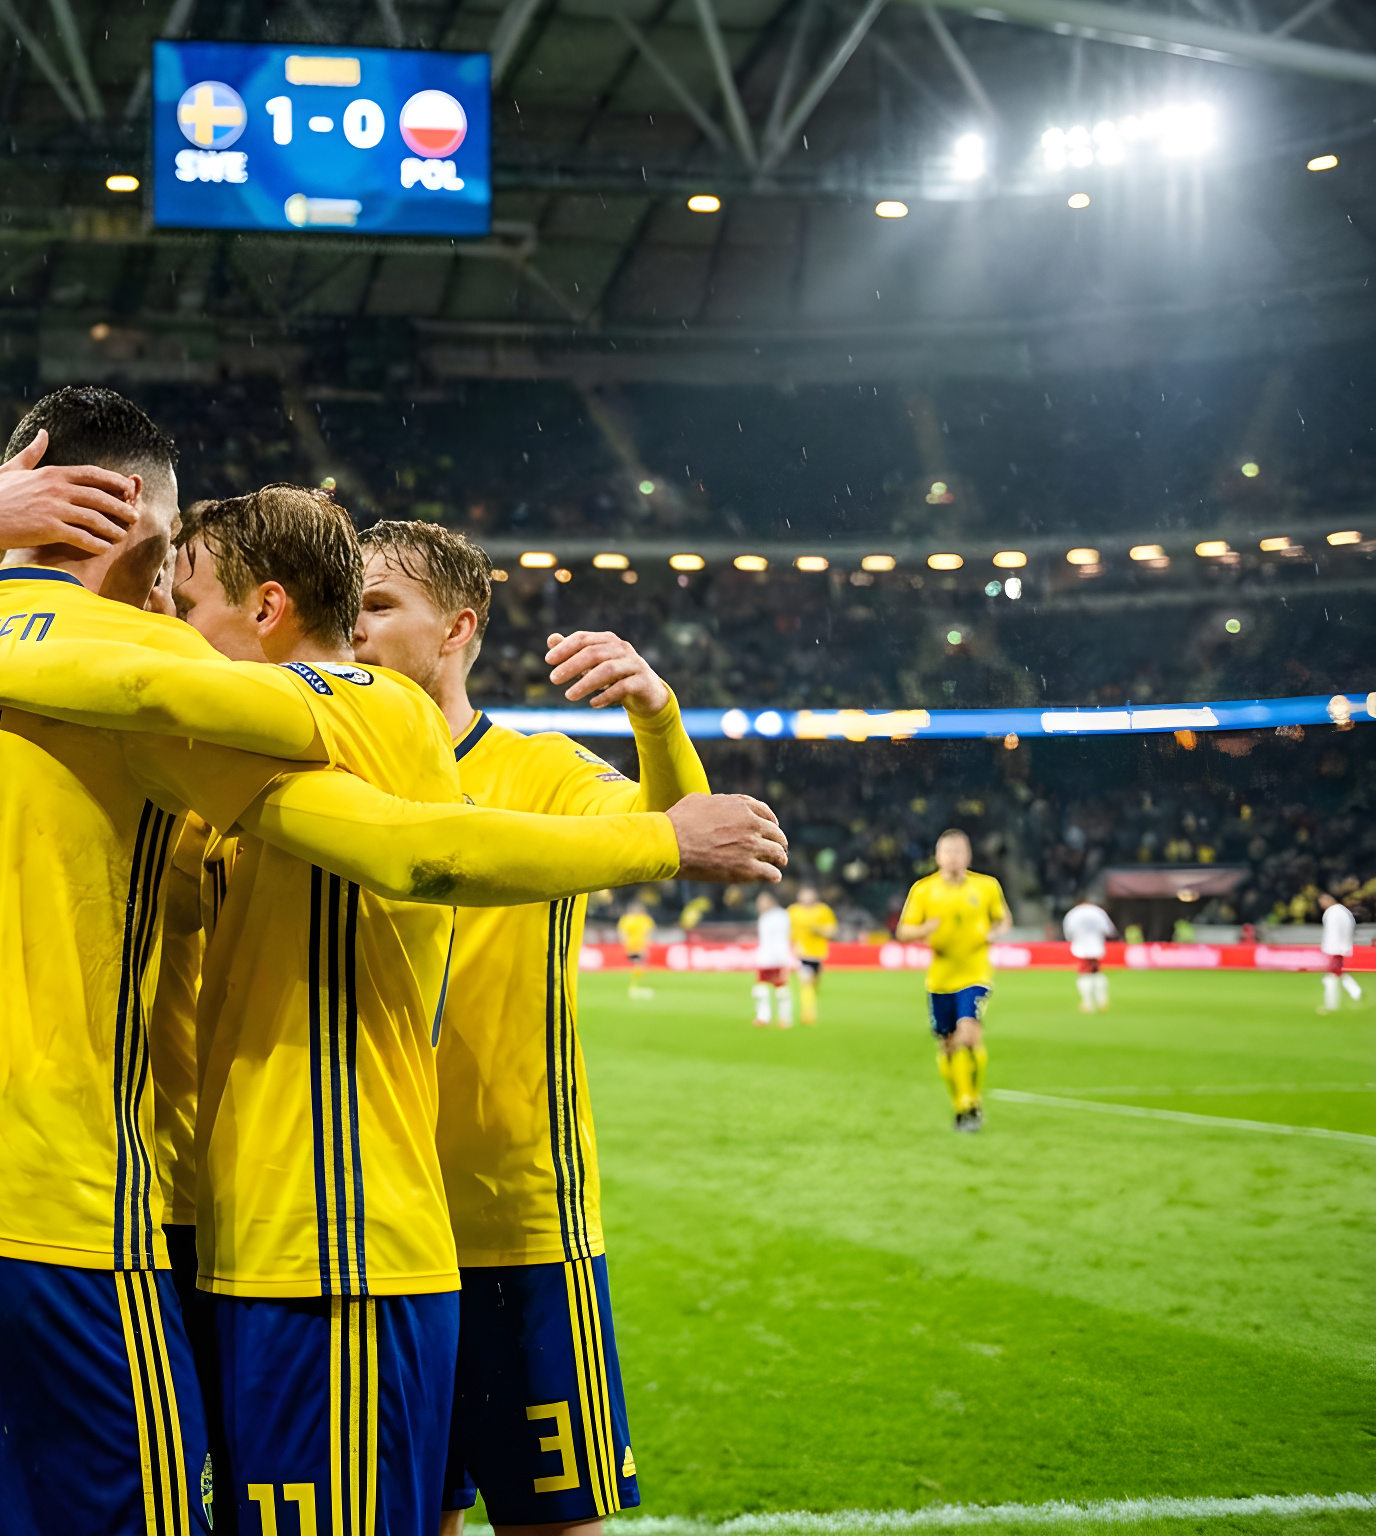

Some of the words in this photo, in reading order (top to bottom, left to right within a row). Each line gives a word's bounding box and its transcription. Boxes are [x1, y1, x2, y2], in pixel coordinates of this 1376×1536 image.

[265, 96, 293, 145] 1
[342, 99, 385, 149] 0
[174, 149, 249, 184] SWE
[400, 157, 465, 191] POL
[526, 1400, 580, 1494] 3
